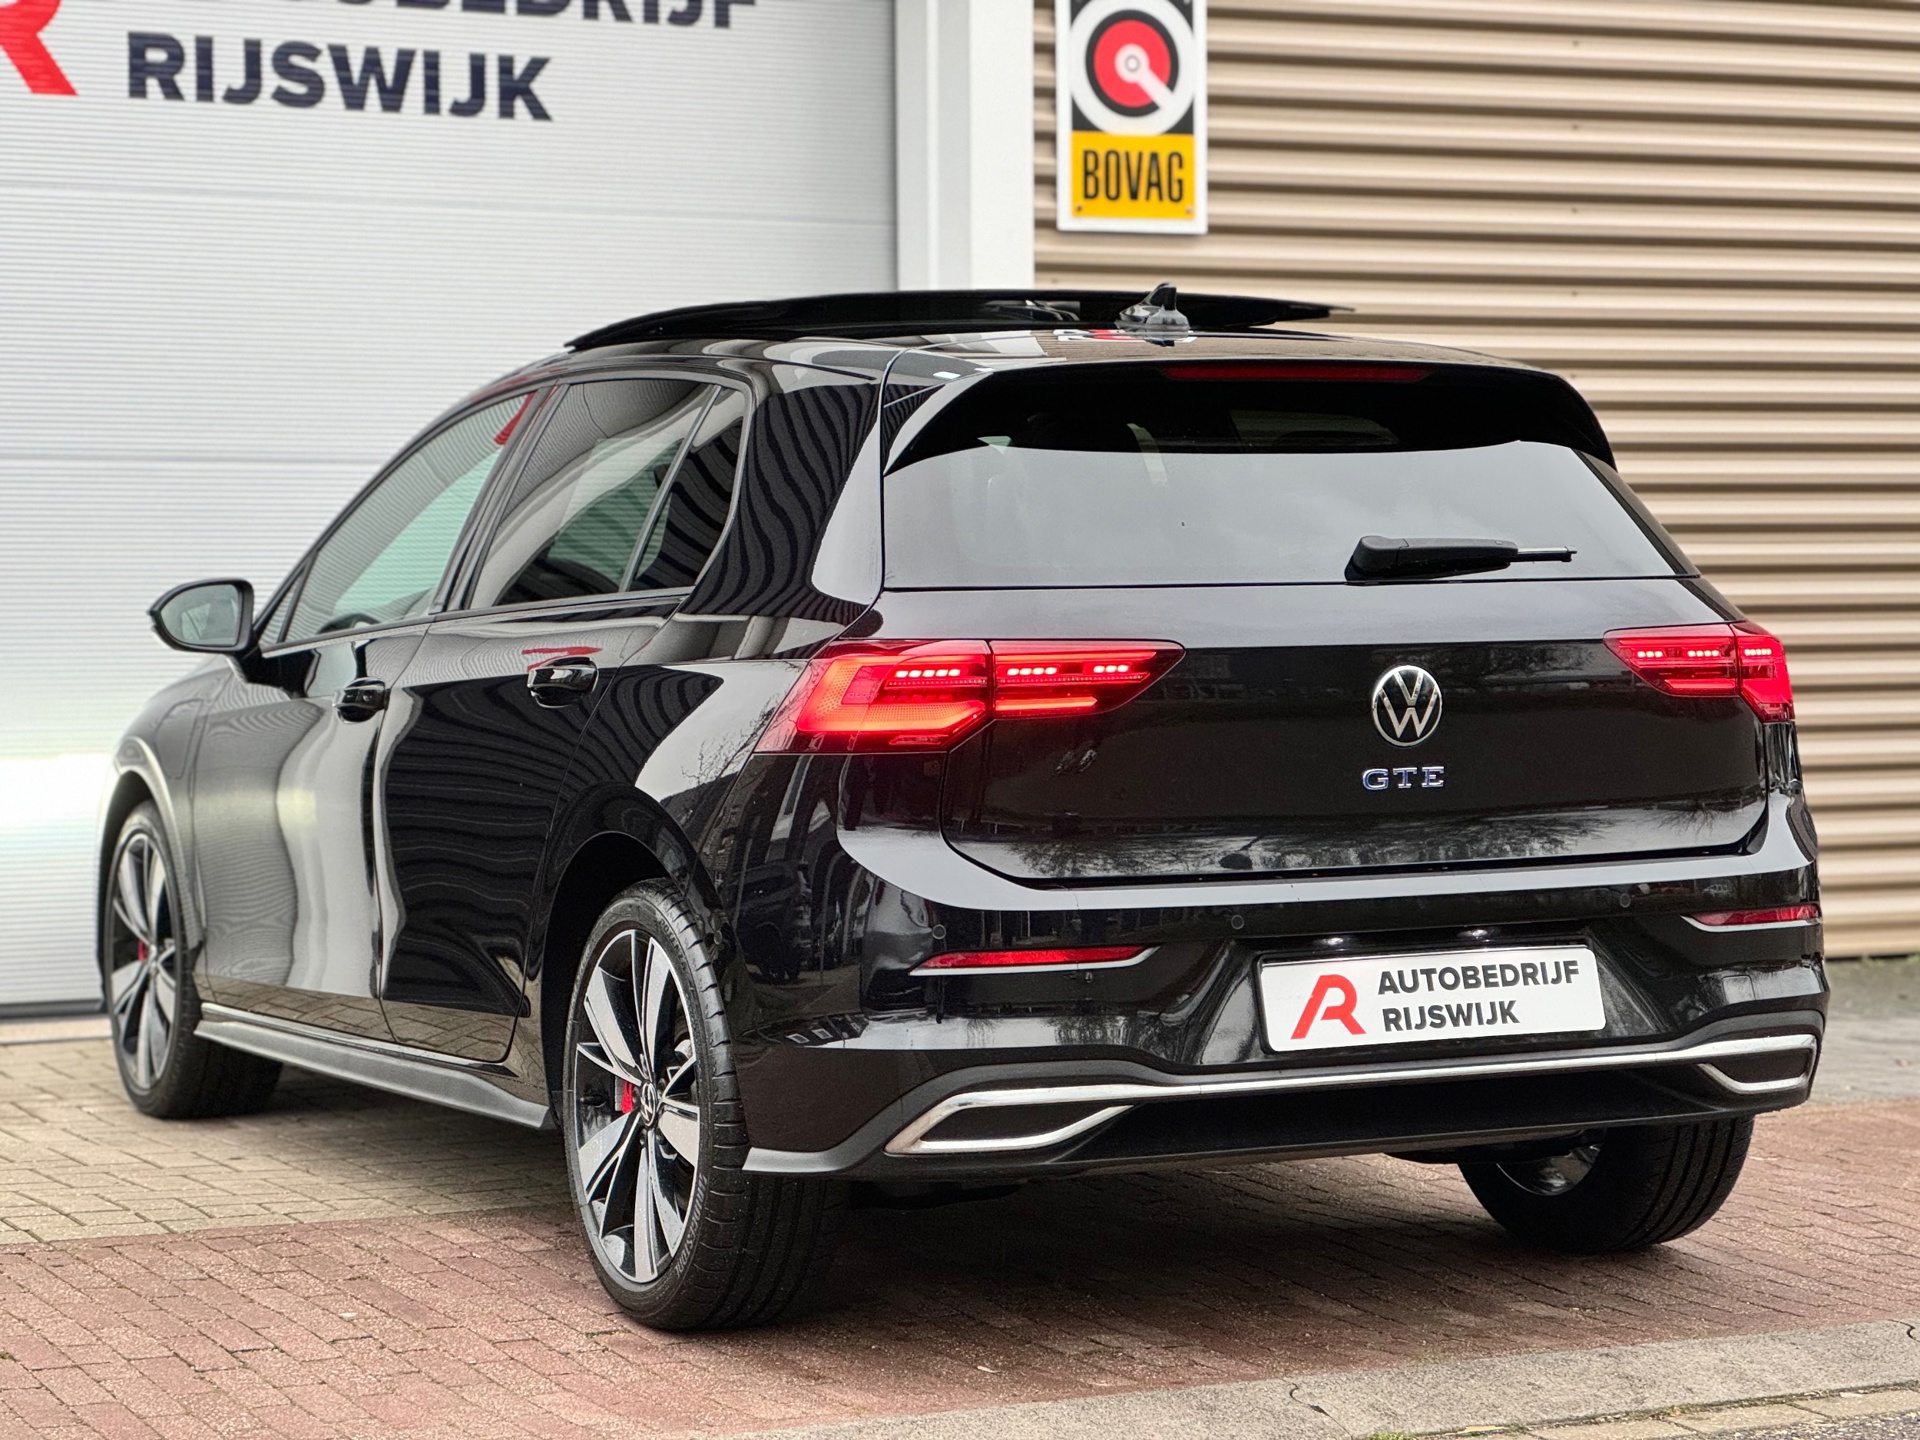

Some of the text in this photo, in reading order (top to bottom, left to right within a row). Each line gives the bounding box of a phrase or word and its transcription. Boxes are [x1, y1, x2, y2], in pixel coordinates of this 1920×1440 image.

[127, 30, 554, 122] RIJSWIJK
[1082, 149, 1185, 203] BOVAG
[1362, 765, 1445, 791] GTE
[1377, 959, 1580, 995] AUTOBEDRIJF
[1382, 999, 1521, 1033] RIJSWIJK
